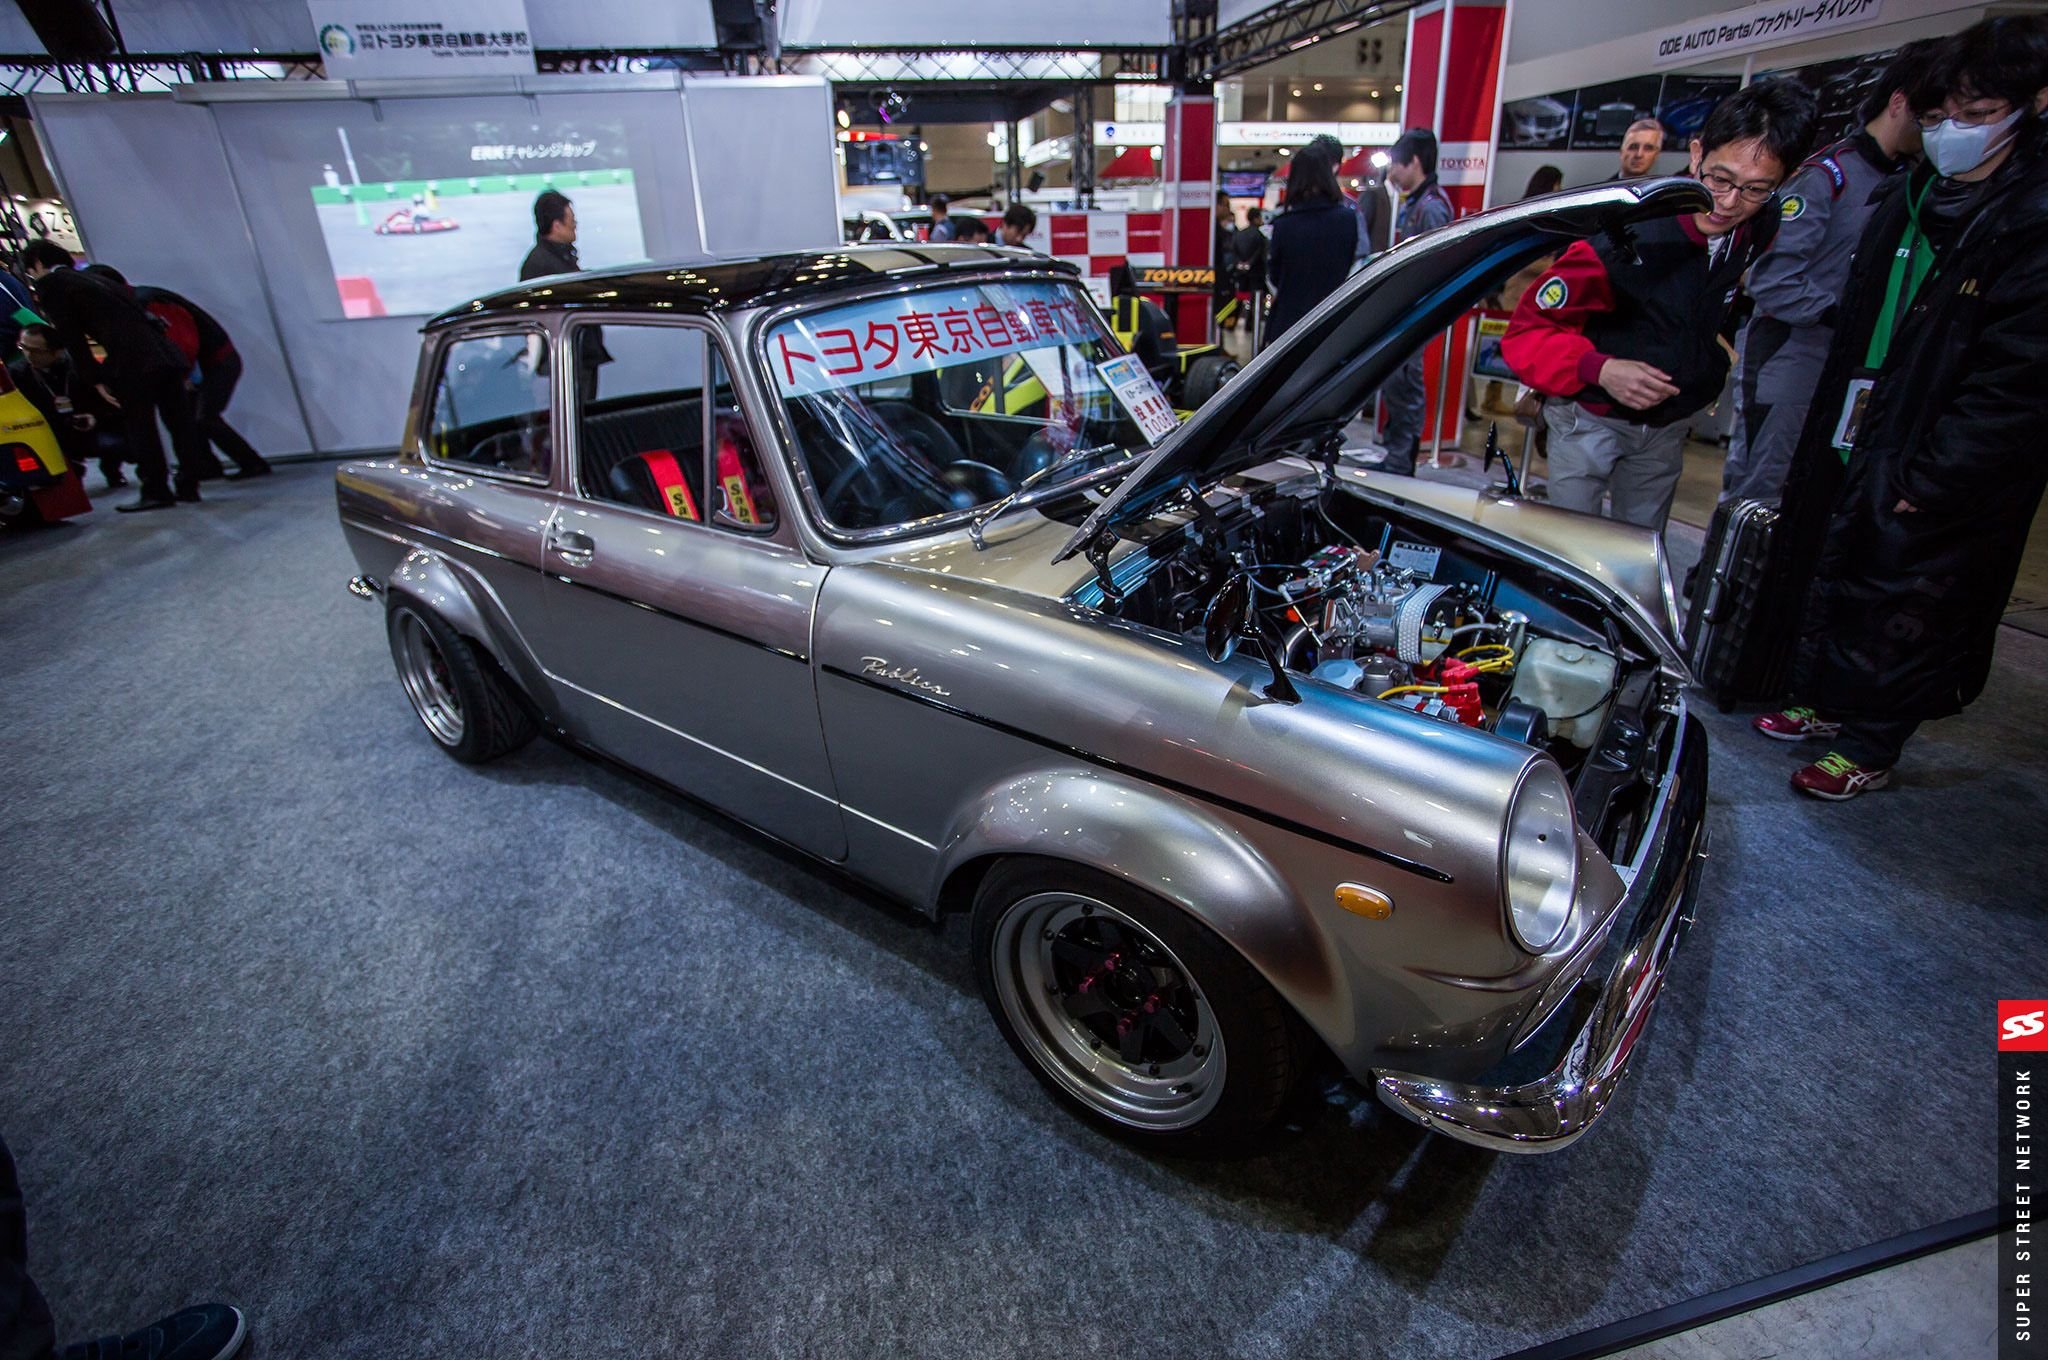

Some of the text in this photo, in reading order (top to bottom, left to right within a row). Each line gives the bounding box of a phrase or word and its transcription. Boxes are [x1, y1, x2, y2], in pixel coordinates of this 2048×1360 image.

[1683, 28, 1716, 50] AUTO
[1440, 158, 1485, 169] TOYOTA
[1143, 268, 1215, 284] TOYOTA
